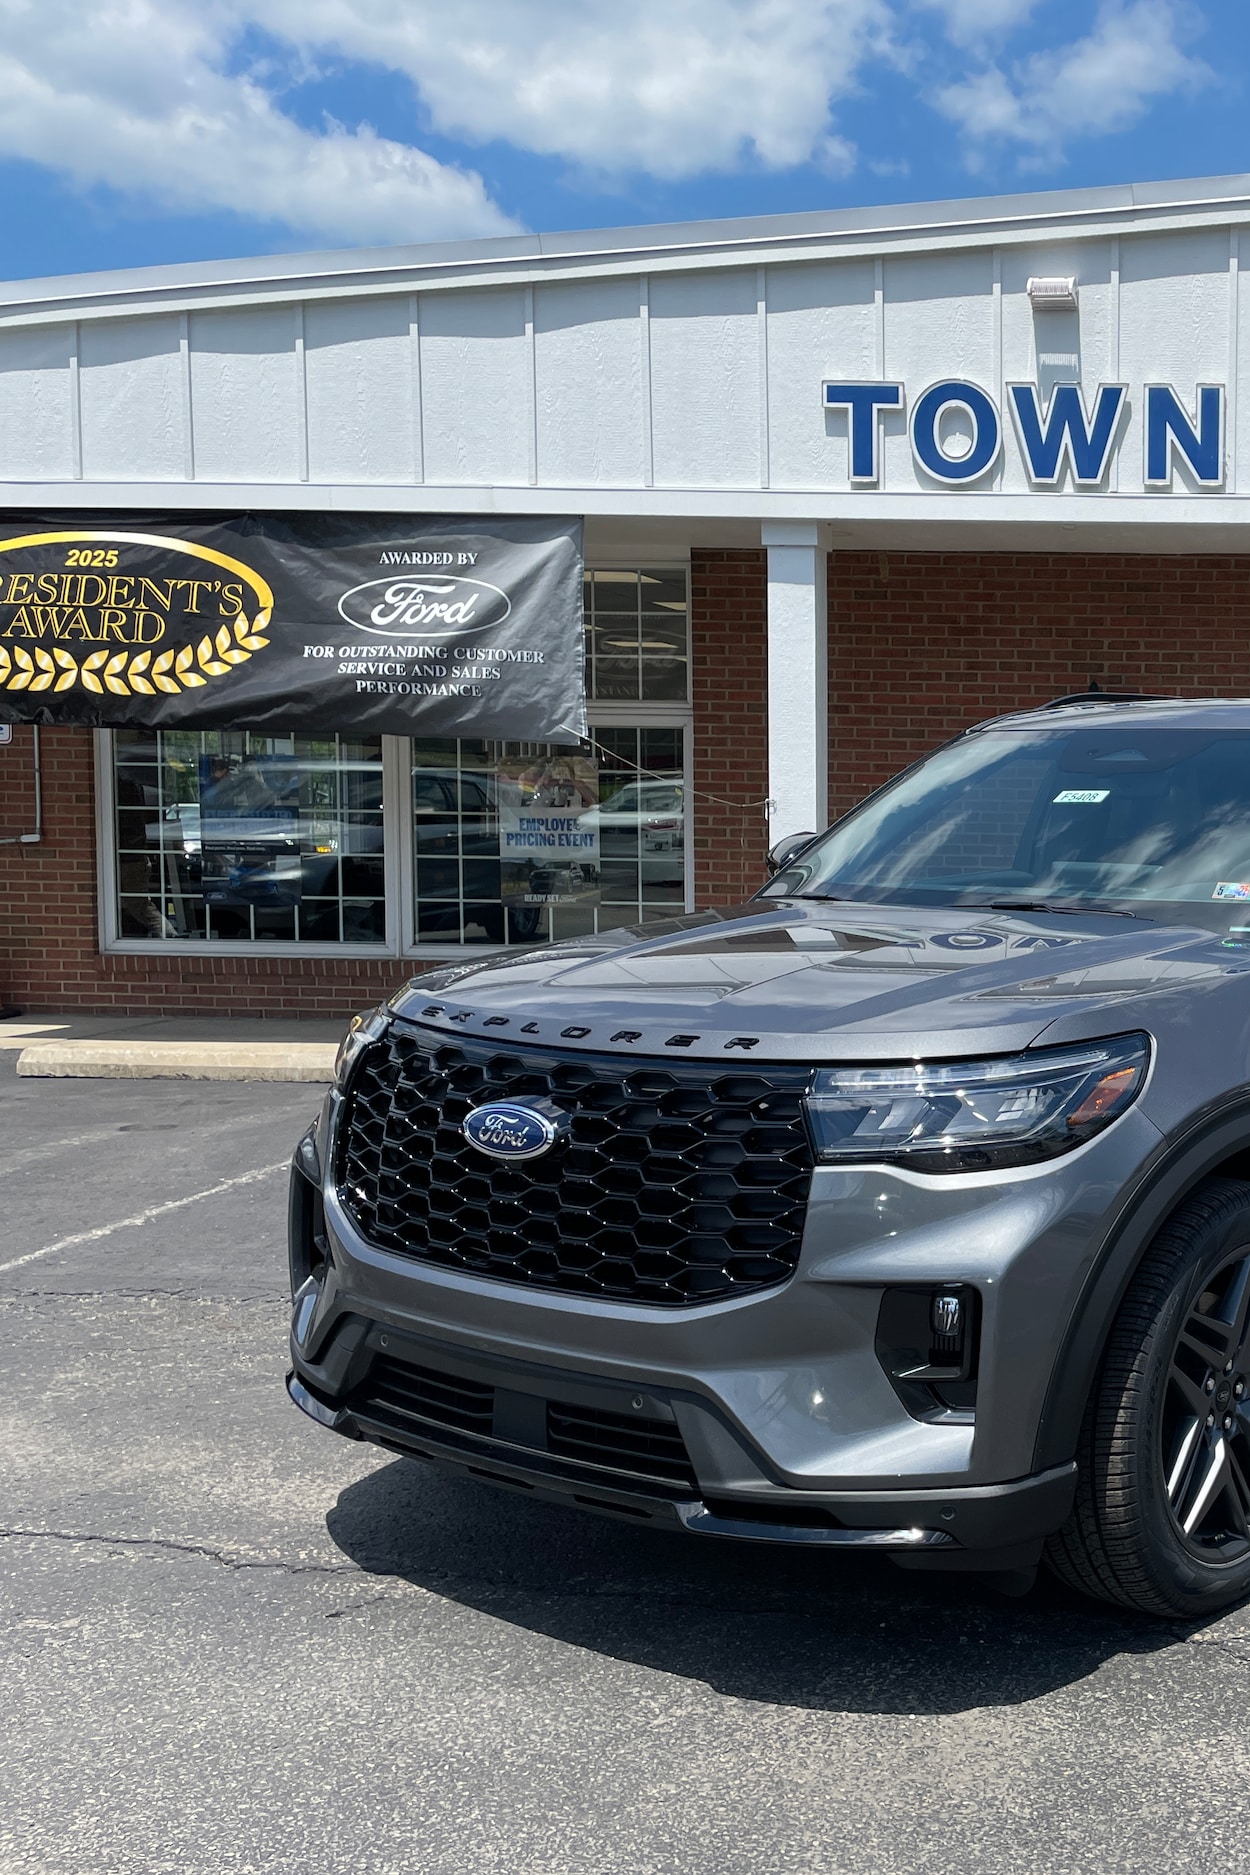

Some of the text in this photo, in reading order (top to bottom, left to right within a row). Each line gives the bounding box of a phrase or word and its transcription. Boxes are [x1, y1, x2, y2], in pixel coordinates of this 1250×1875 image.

[821, 378, 1228, 487] TOWN
[64, 549, 119, 568] 2025
[379, 551, 479, 566] AWARDED BY
[0, 572, 244, 617] ESIDENT'S
[370, 582, 480, 626] Ford
[1, 605, 167, 644] AWARD
[302, 645, 545, 664] FOR OUTSTANDING CUSTOMER
[337, 662, 501, 680] SERVICE AND SALES
[355, 680, 482, 697] PERFORMANCE
[1060, 792, 1100, 801] F5408
[506, 832, 595, 848] PRICING EVENT
[524, 894, 546, 902] READY
[547, 894, 560, 902] SET
[420, 1004, 761, 1050] EXPLORER
[477, 1112, 528, 1149] Ford
